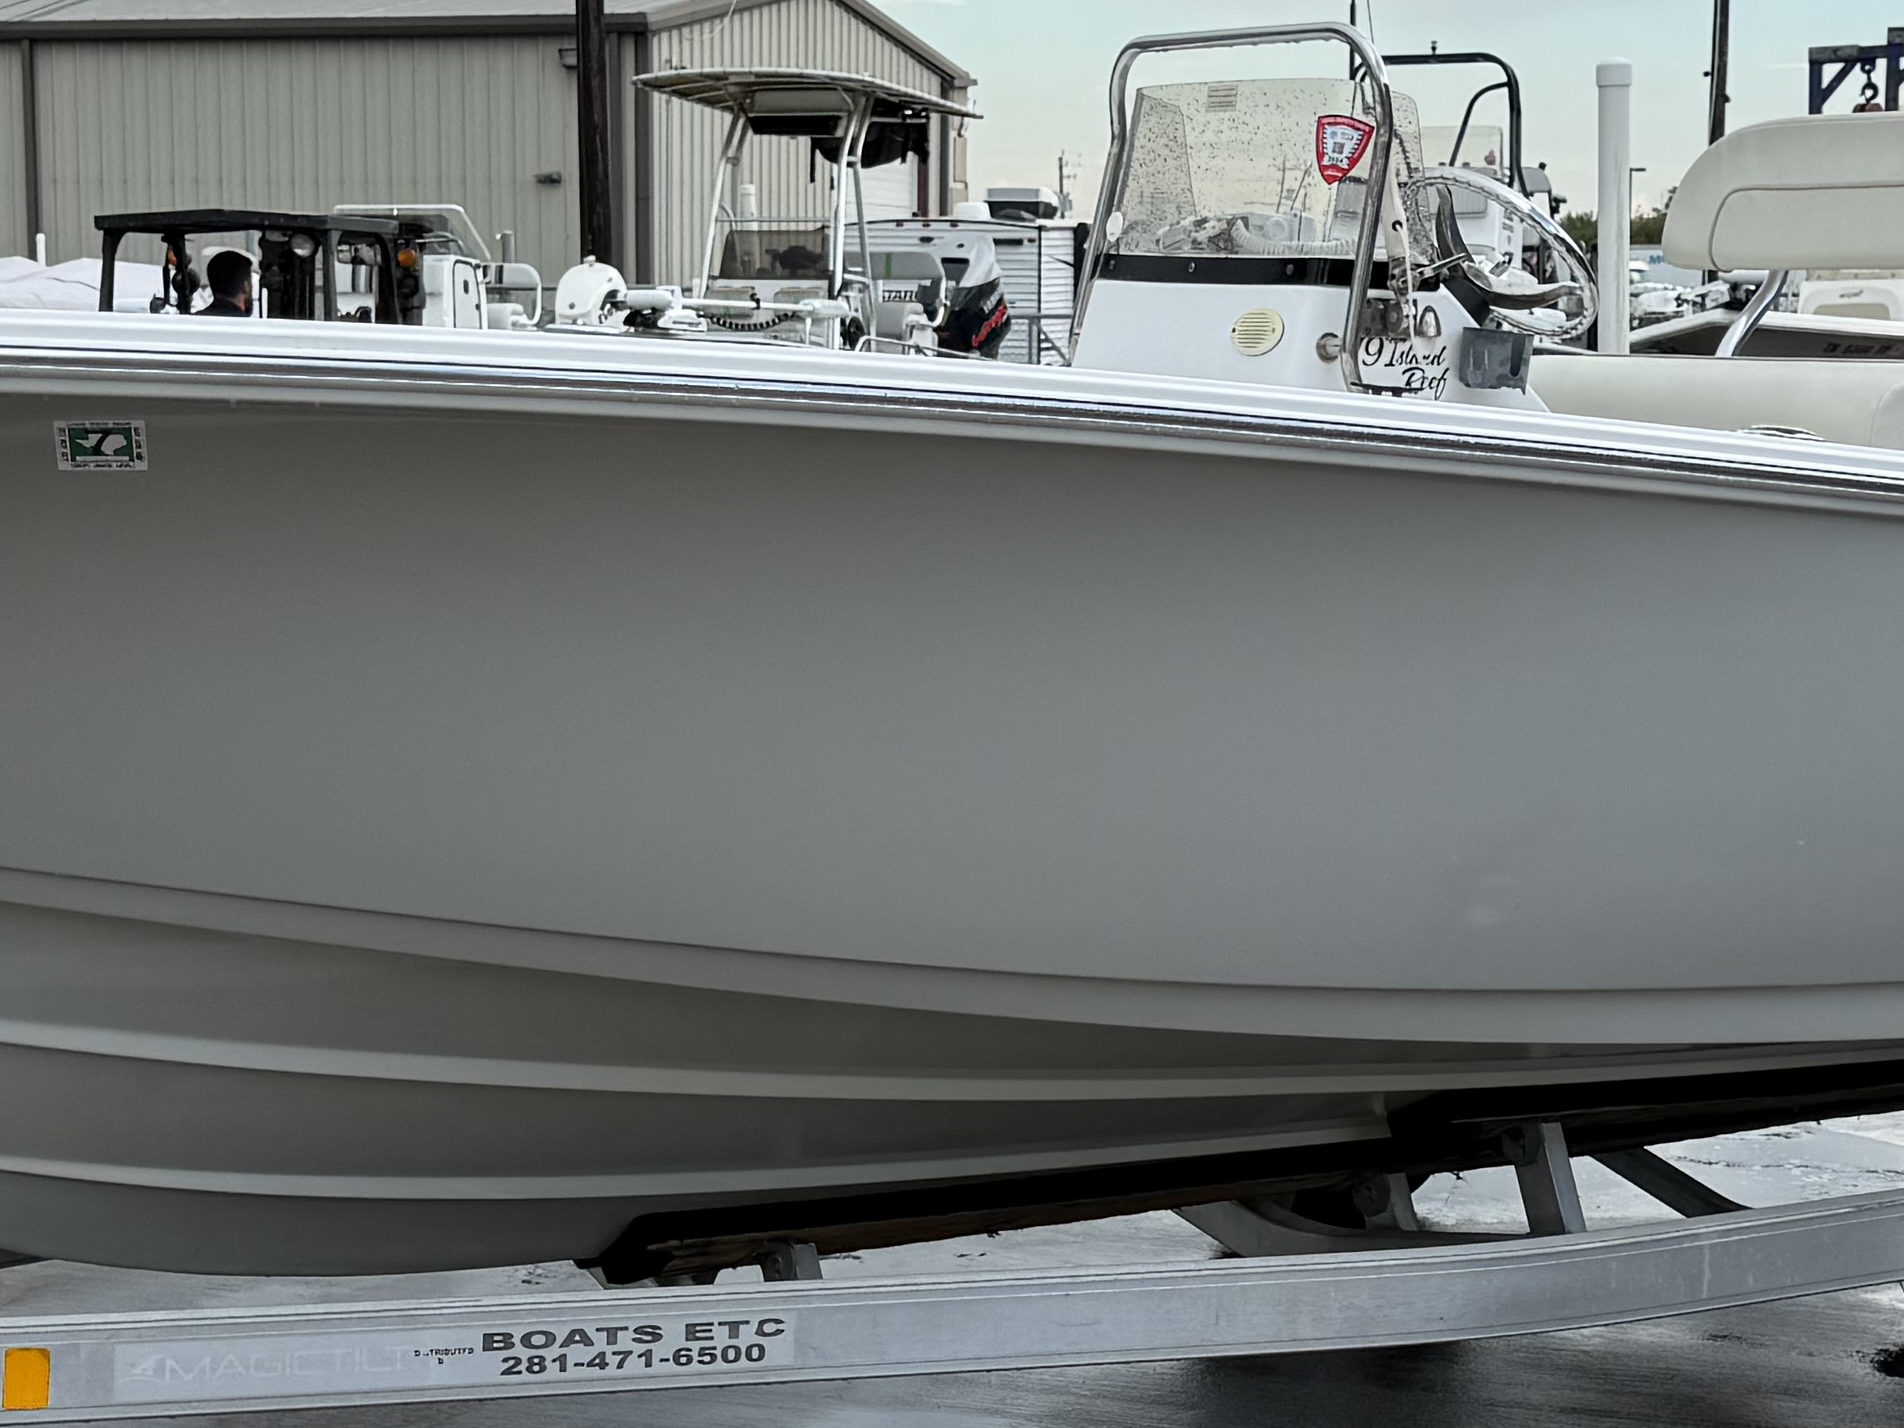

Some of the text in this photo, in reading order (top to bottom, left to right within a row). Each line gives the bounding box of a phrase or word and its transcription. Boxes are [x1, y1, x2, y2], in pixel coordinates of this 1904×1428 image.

[482, 1318, 787, 1353] BOATS ETC
[500, 1342, 767, 1376] 281-471-6500
